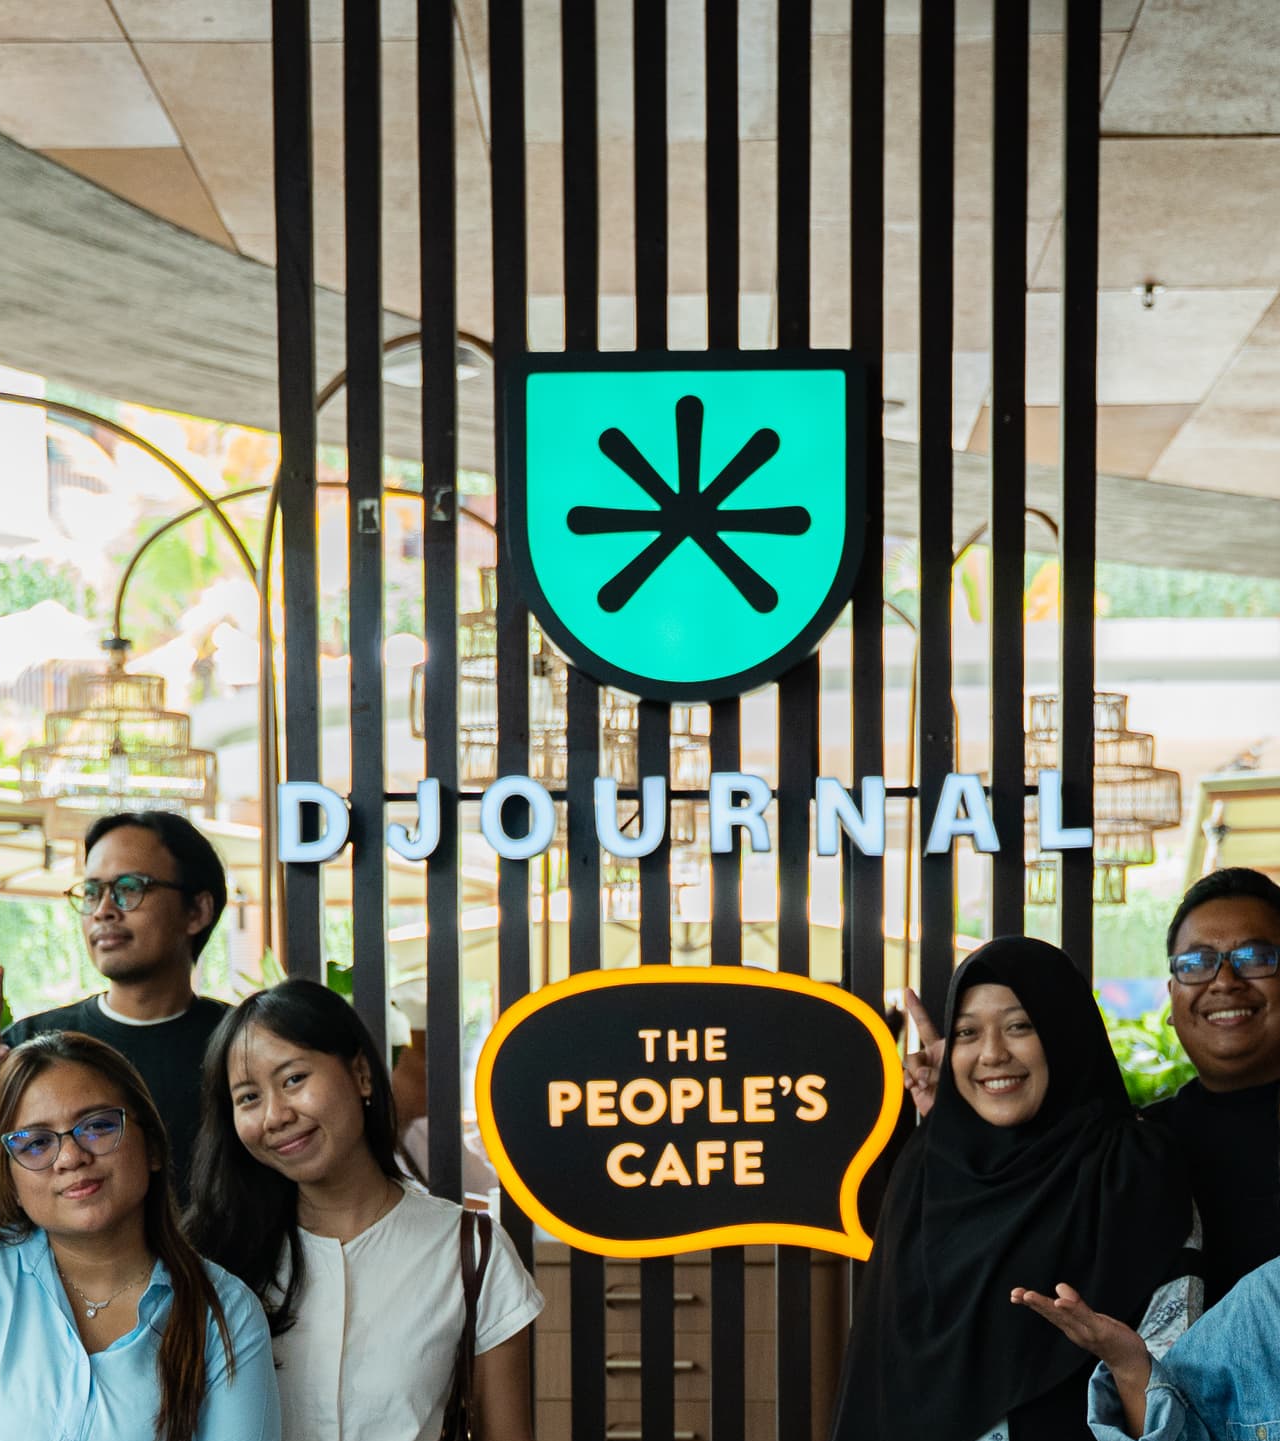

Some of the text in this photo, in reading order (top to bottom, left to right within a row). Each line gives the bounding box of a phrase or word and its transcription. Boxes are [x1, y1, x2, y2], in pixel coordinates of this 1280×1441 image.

[277, 770, 1094, 864] DJOURNAL
[639, 1028, 727, 1063] THE
[548, 1074, 828, 1127] PEOPLE'S
[606, 1140, 765, 1188] CAFE
